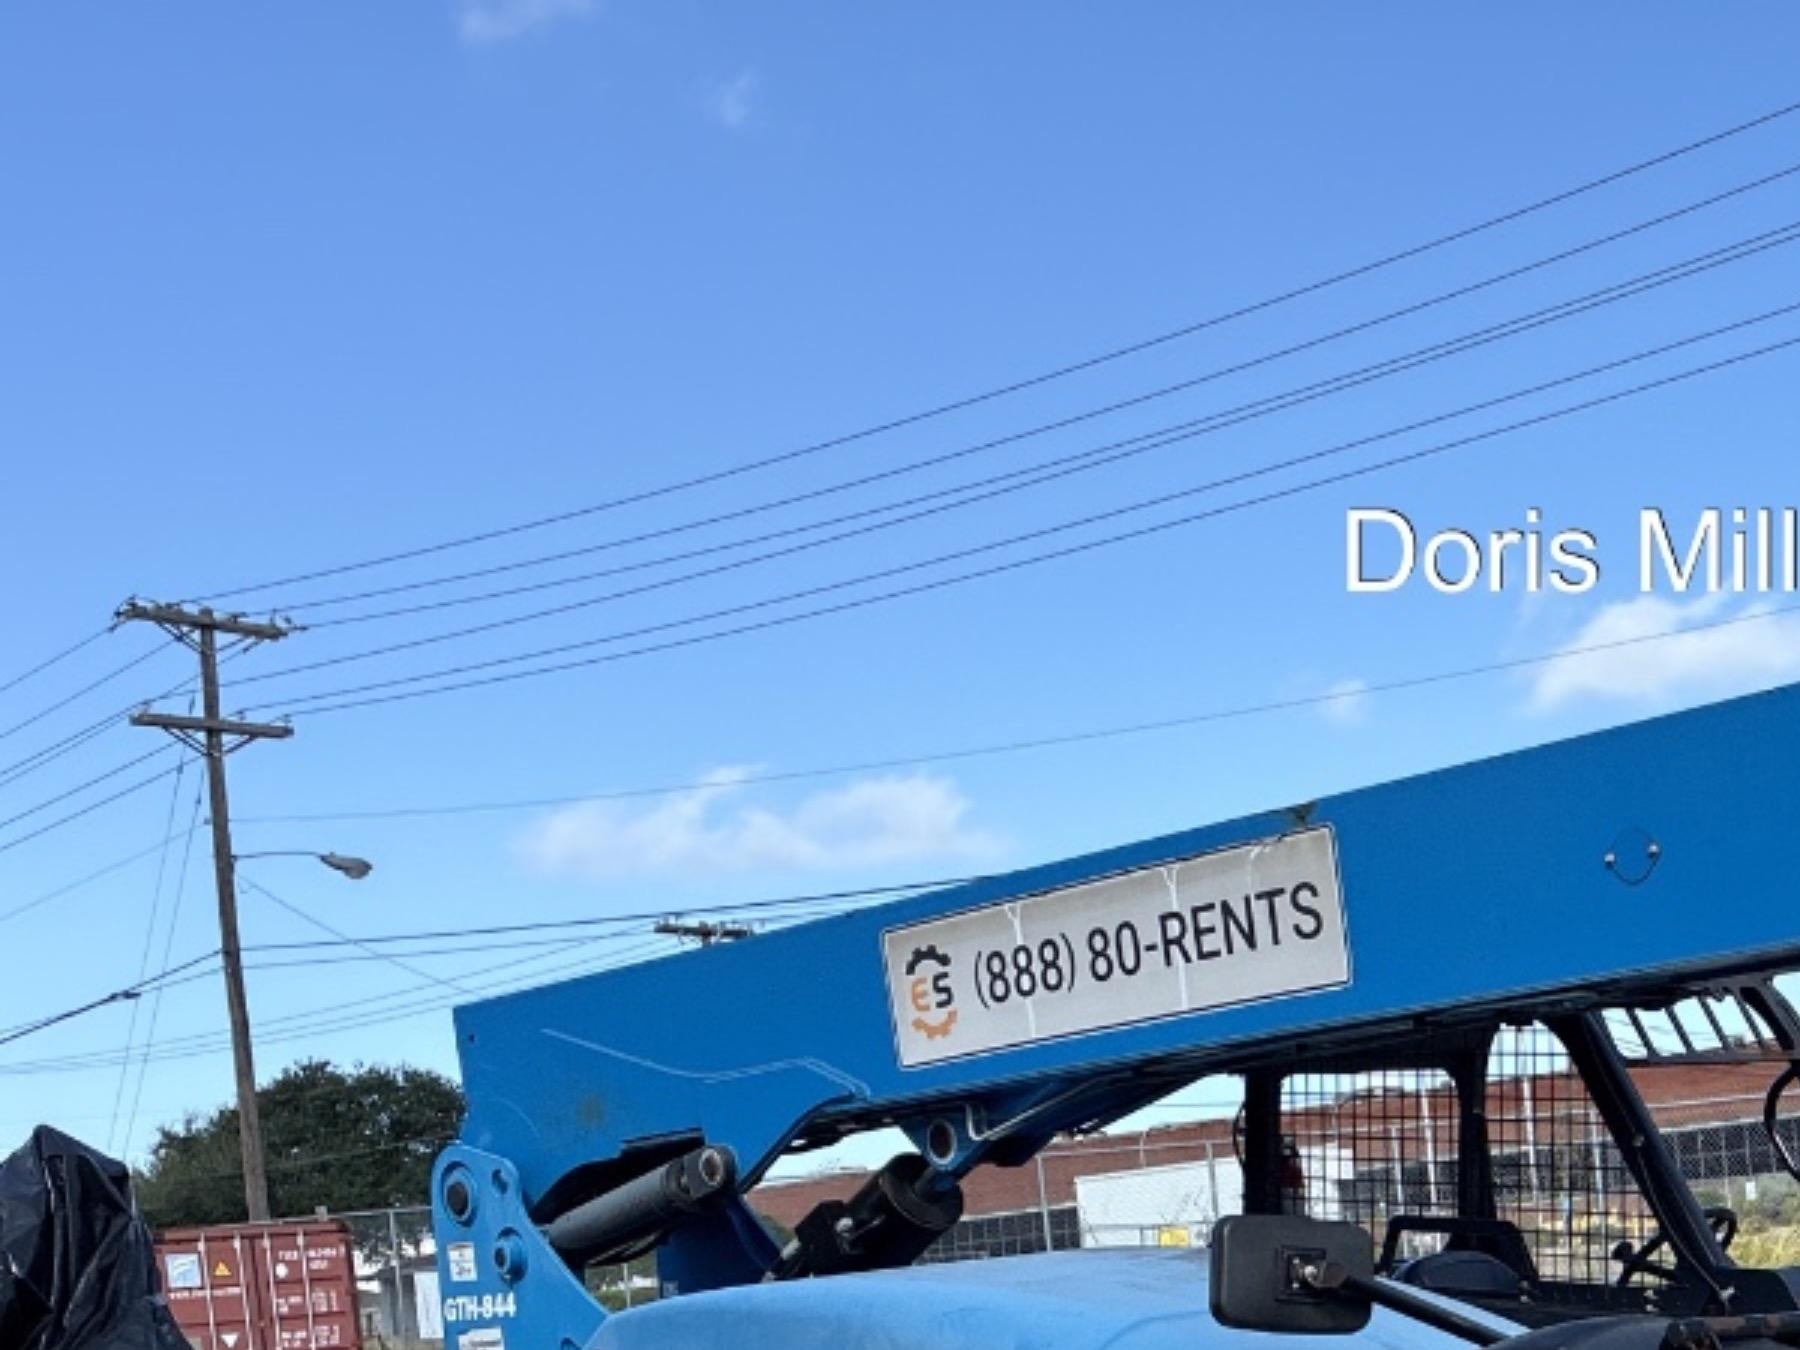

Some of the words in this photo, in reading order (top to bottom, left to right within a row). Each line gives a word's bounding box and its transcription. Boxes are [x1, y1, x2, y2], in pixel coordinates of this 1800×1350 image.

[973, 933, 1076, 1010] (888)
[1087, 881, 1325, 983] 80-RENTS
[444, 1292, 517, 1321] GTH-844
